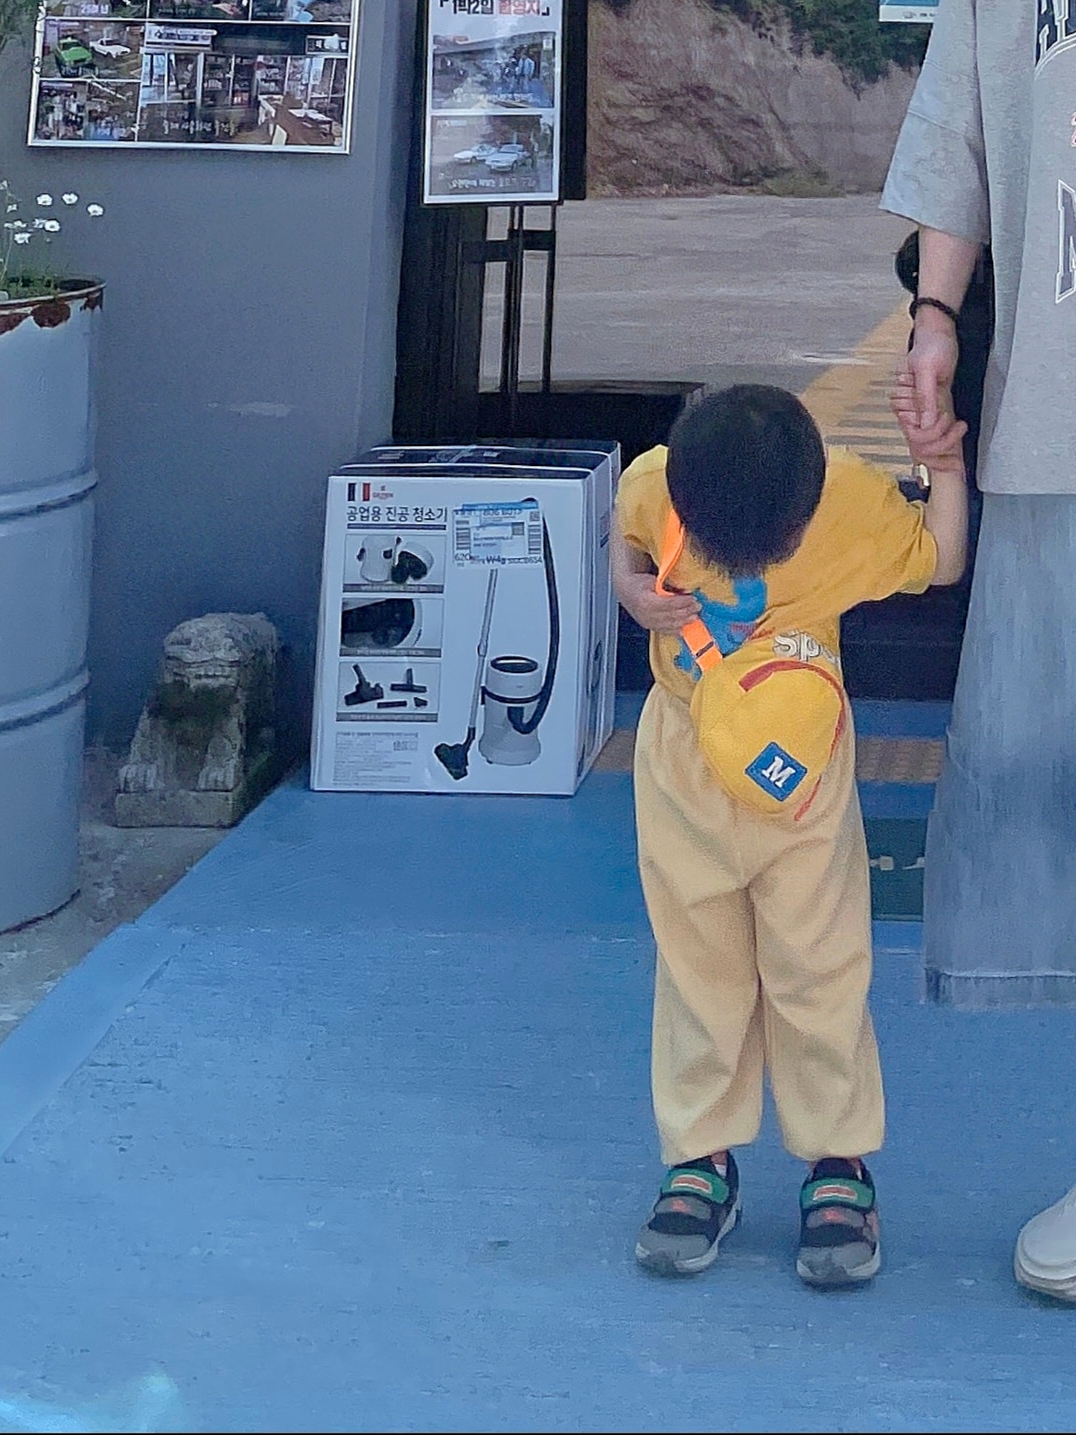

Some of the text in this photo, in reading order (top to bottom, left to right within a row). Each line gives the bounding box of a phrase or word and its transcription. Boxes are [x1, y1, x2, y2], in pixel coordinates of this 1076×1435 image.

[347, 506, 382, 522] 공업용
[385, 507, 410, 522] 진공
[413, 507, 448, 522] 청소기
[762, 757, 795, 788] M
